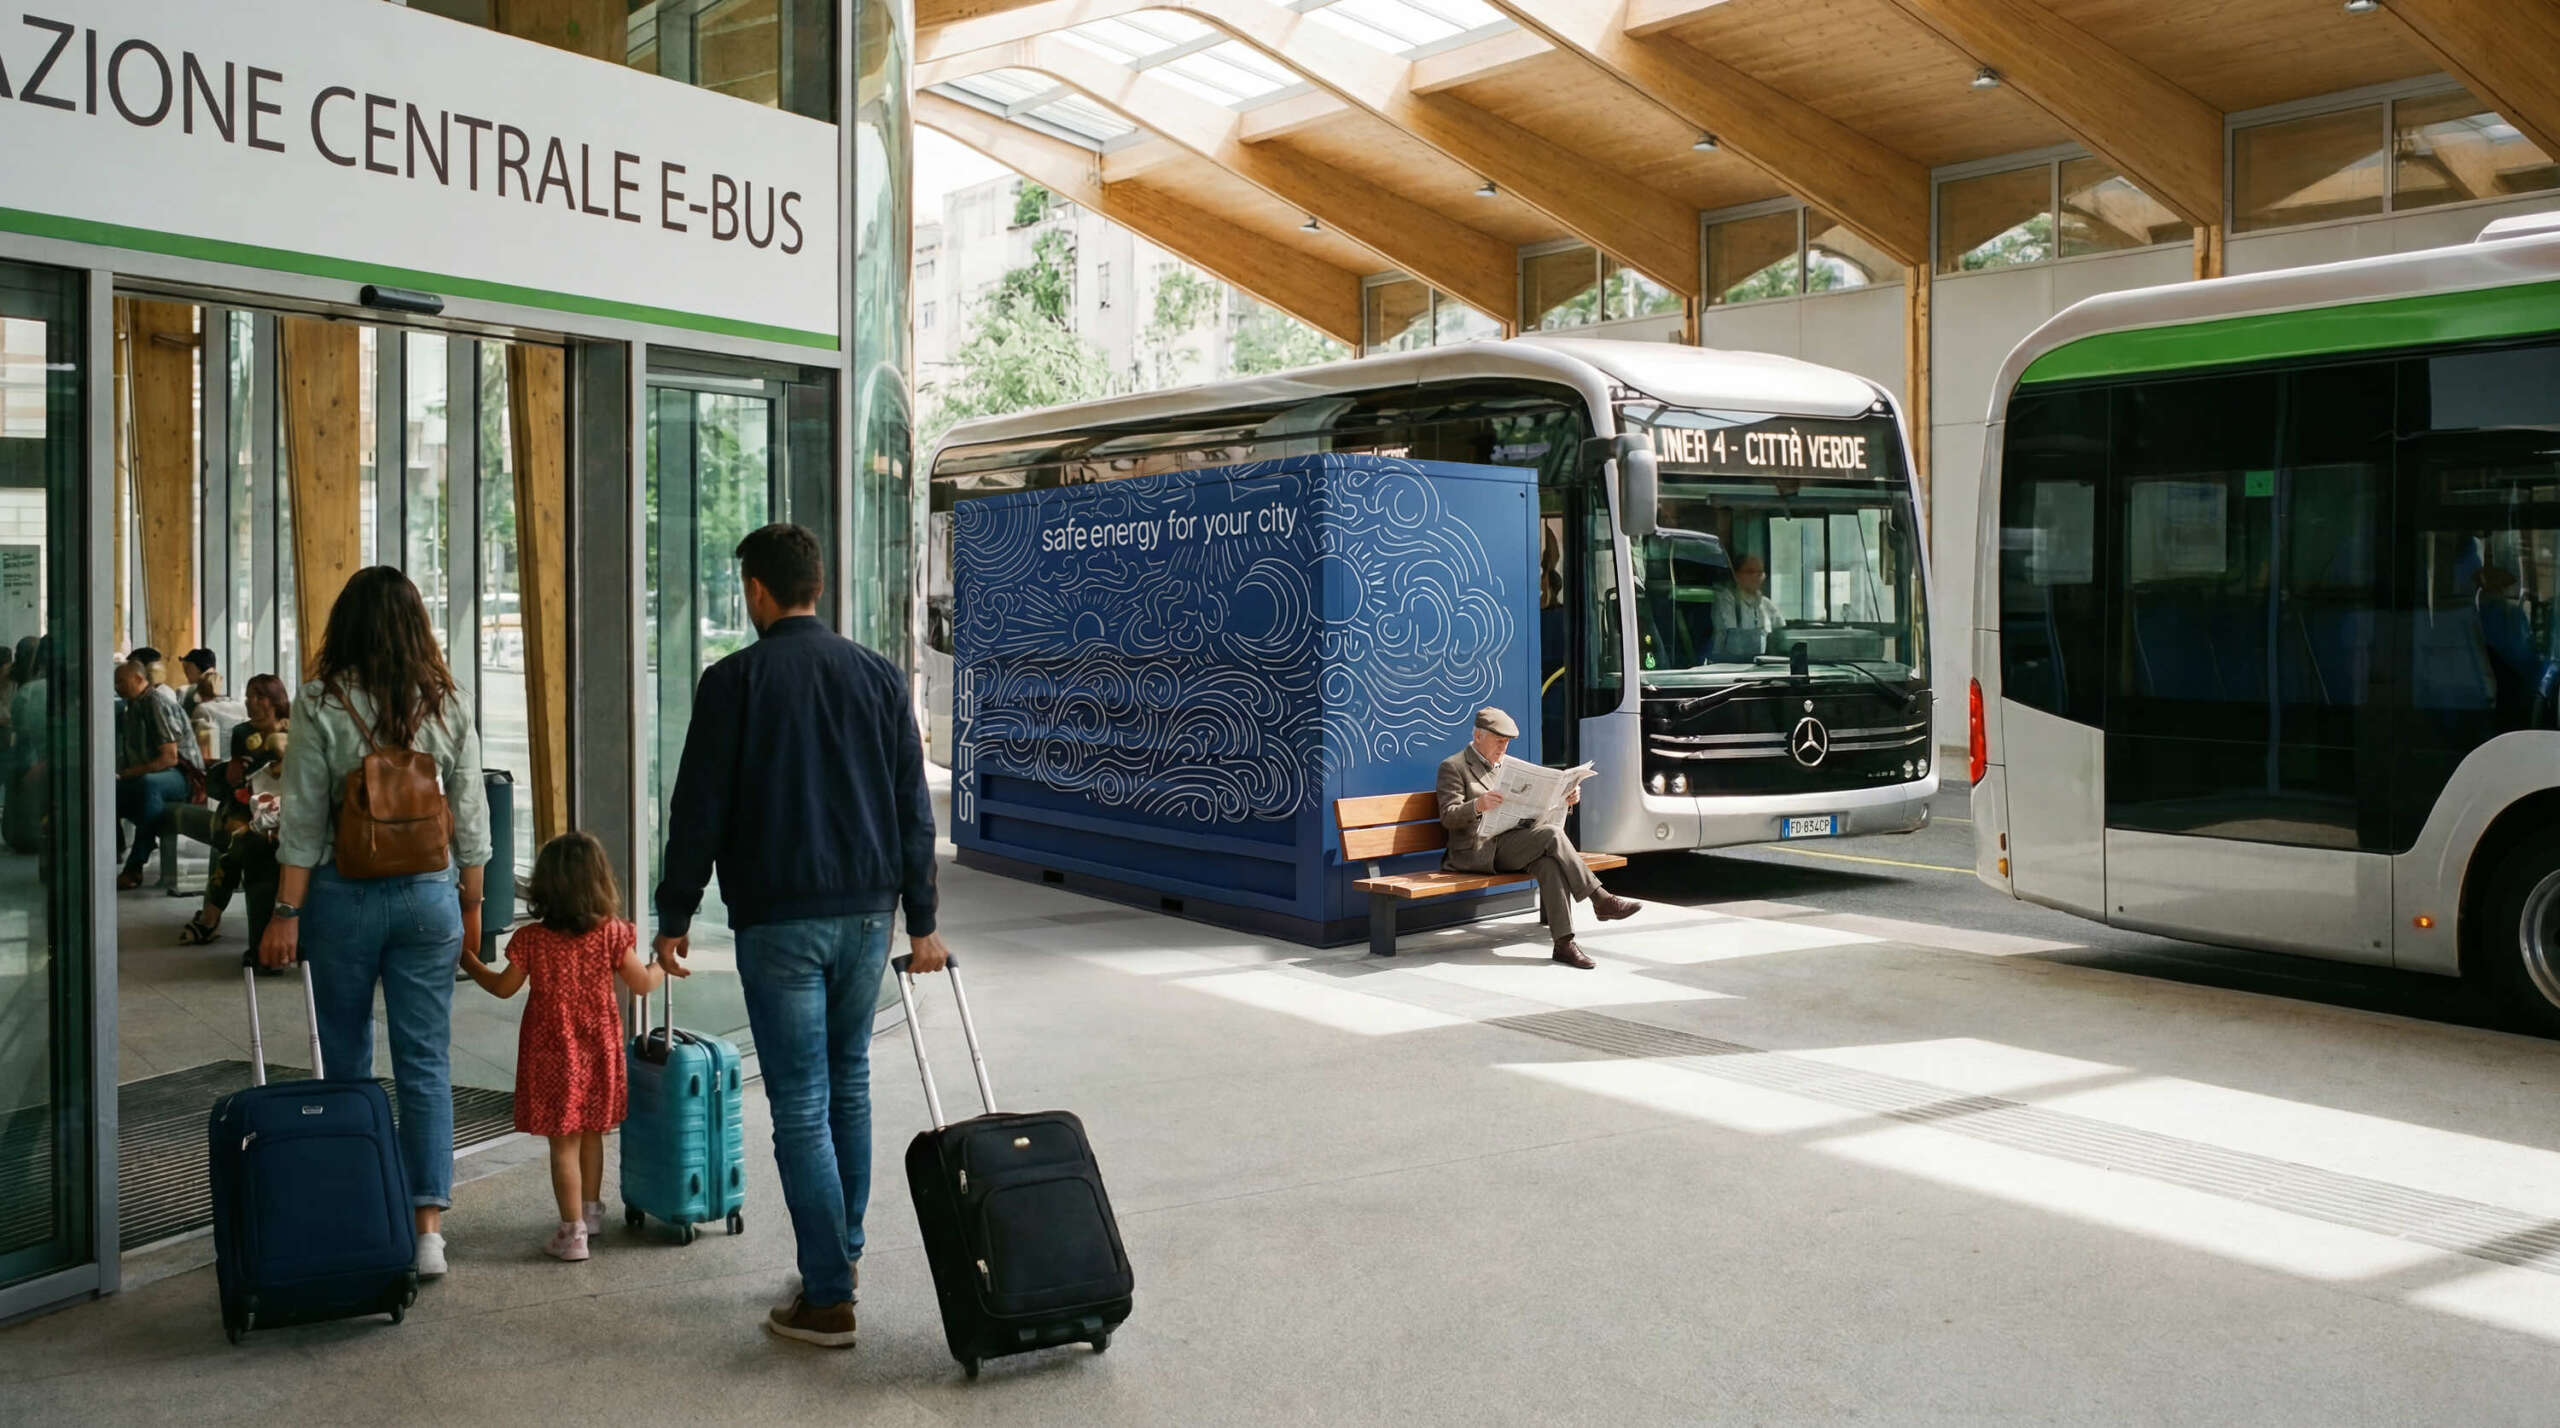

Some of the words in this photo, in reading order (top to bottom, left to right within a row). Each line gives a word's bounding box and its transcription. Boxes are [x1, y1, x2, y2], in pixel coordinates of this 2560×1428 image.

[0, 14, 285, 153] ZIONE
[310, 86, 641, 223] CENTRALE
[661, 161, 803, 255] E-BUS
[1648, 427, 1708, 463] LINEA
[1712, 430, 1726, 464] 4
[1745, 427, 1803, 467] CITTÀ
[1806, 434, 1867, 469] VERDE
[1168, 510, 1197, 540] for
[1203, 511, 1252, 545] your
[1258, 502, 1297, 539] city
